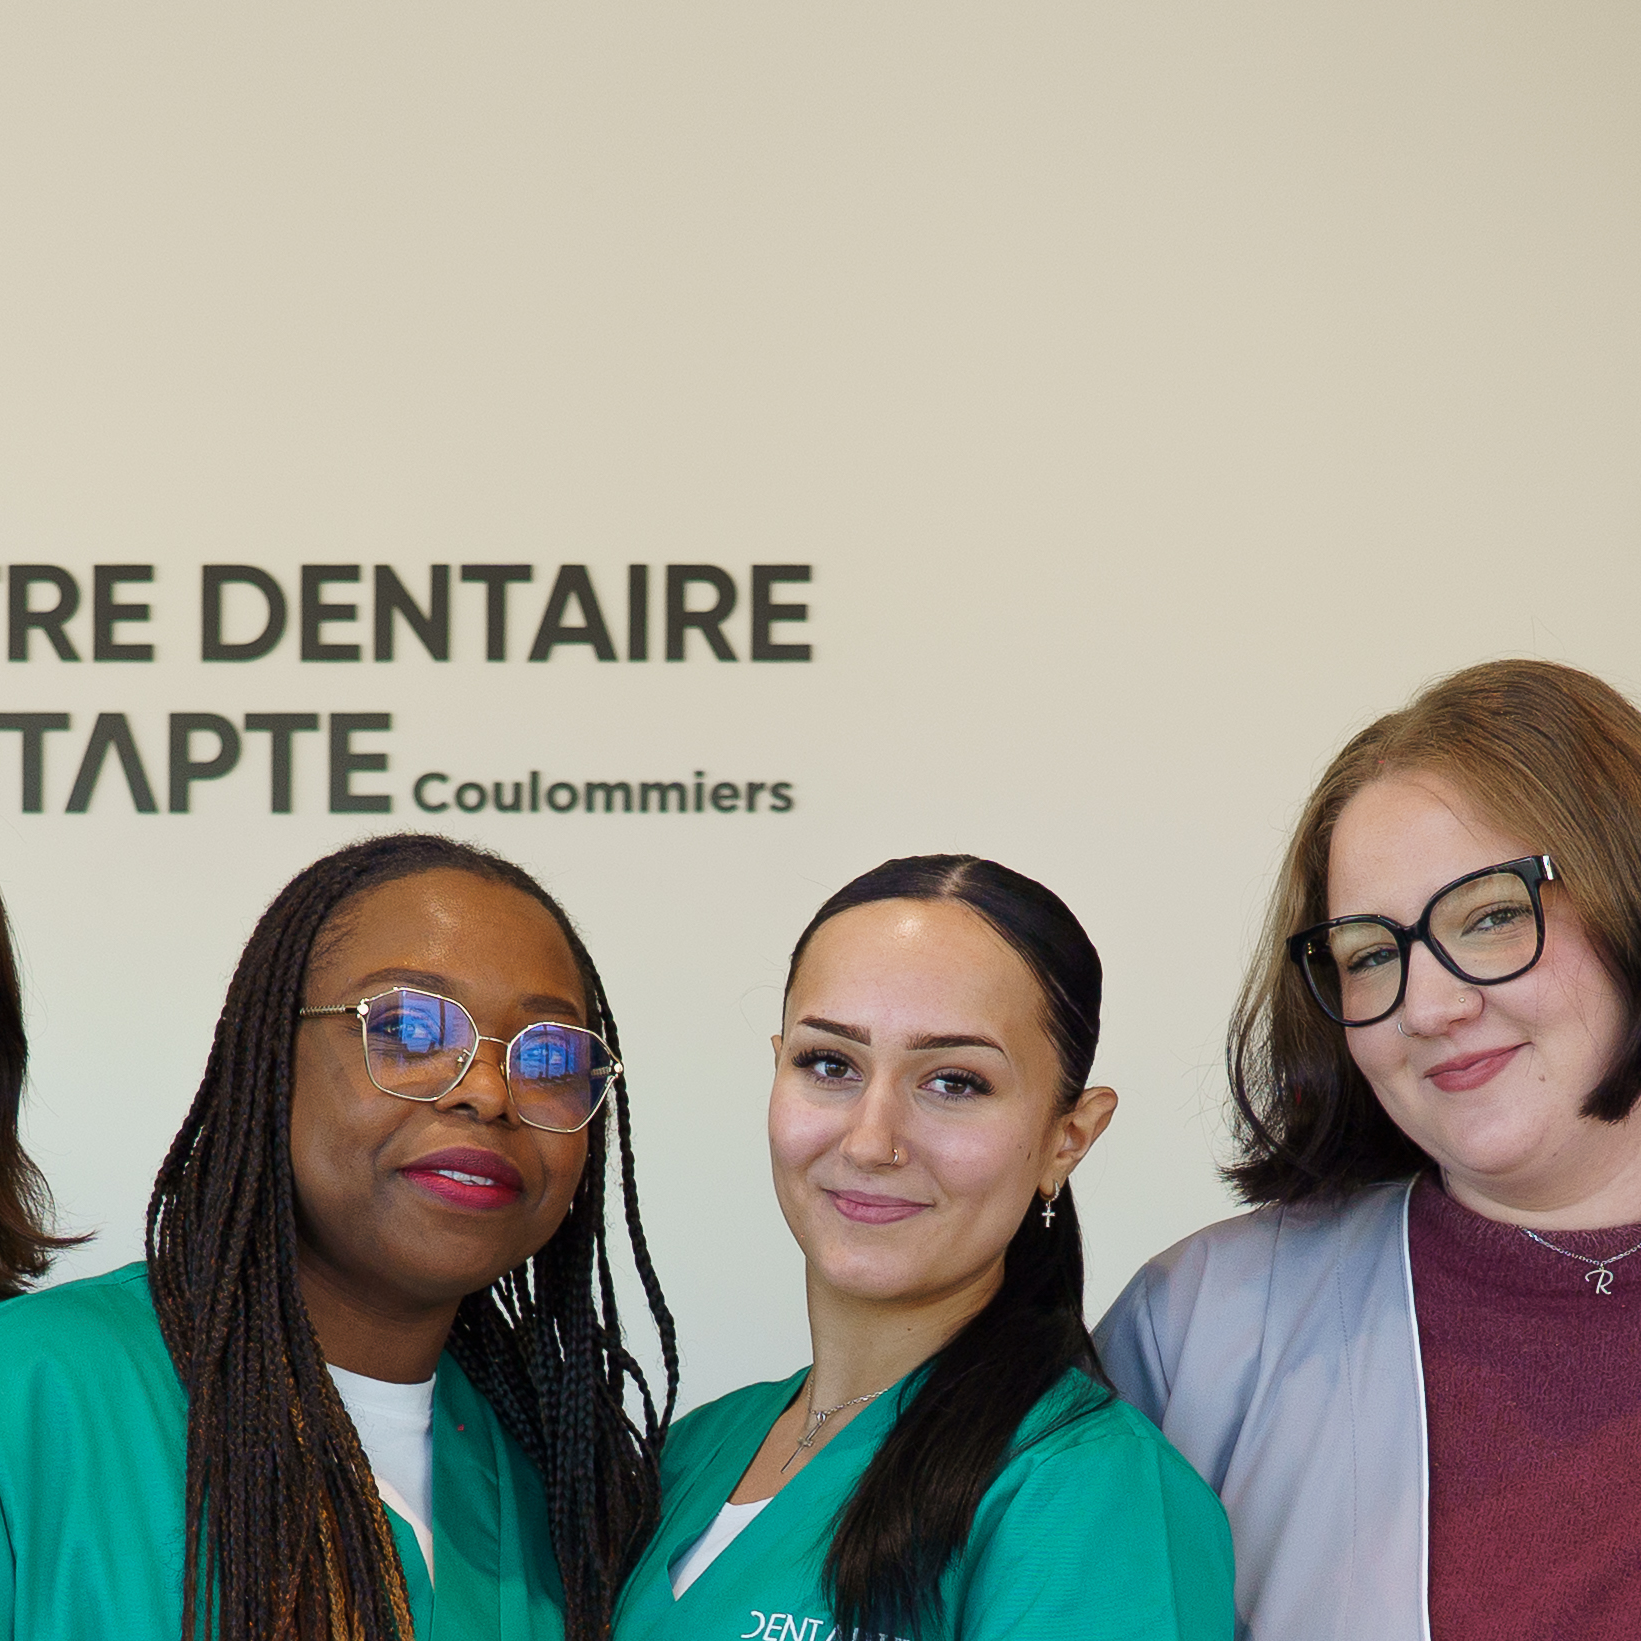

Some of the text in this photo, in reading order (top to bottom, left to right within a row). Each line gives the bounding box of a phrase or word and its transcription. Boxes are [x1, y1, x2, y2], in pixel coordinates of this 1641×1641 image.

[200, 563, 813, 664] DENTAIRE
[411, 771, 794, 815] Coulommiers
[1585, 1269, 1614, 1295] R
